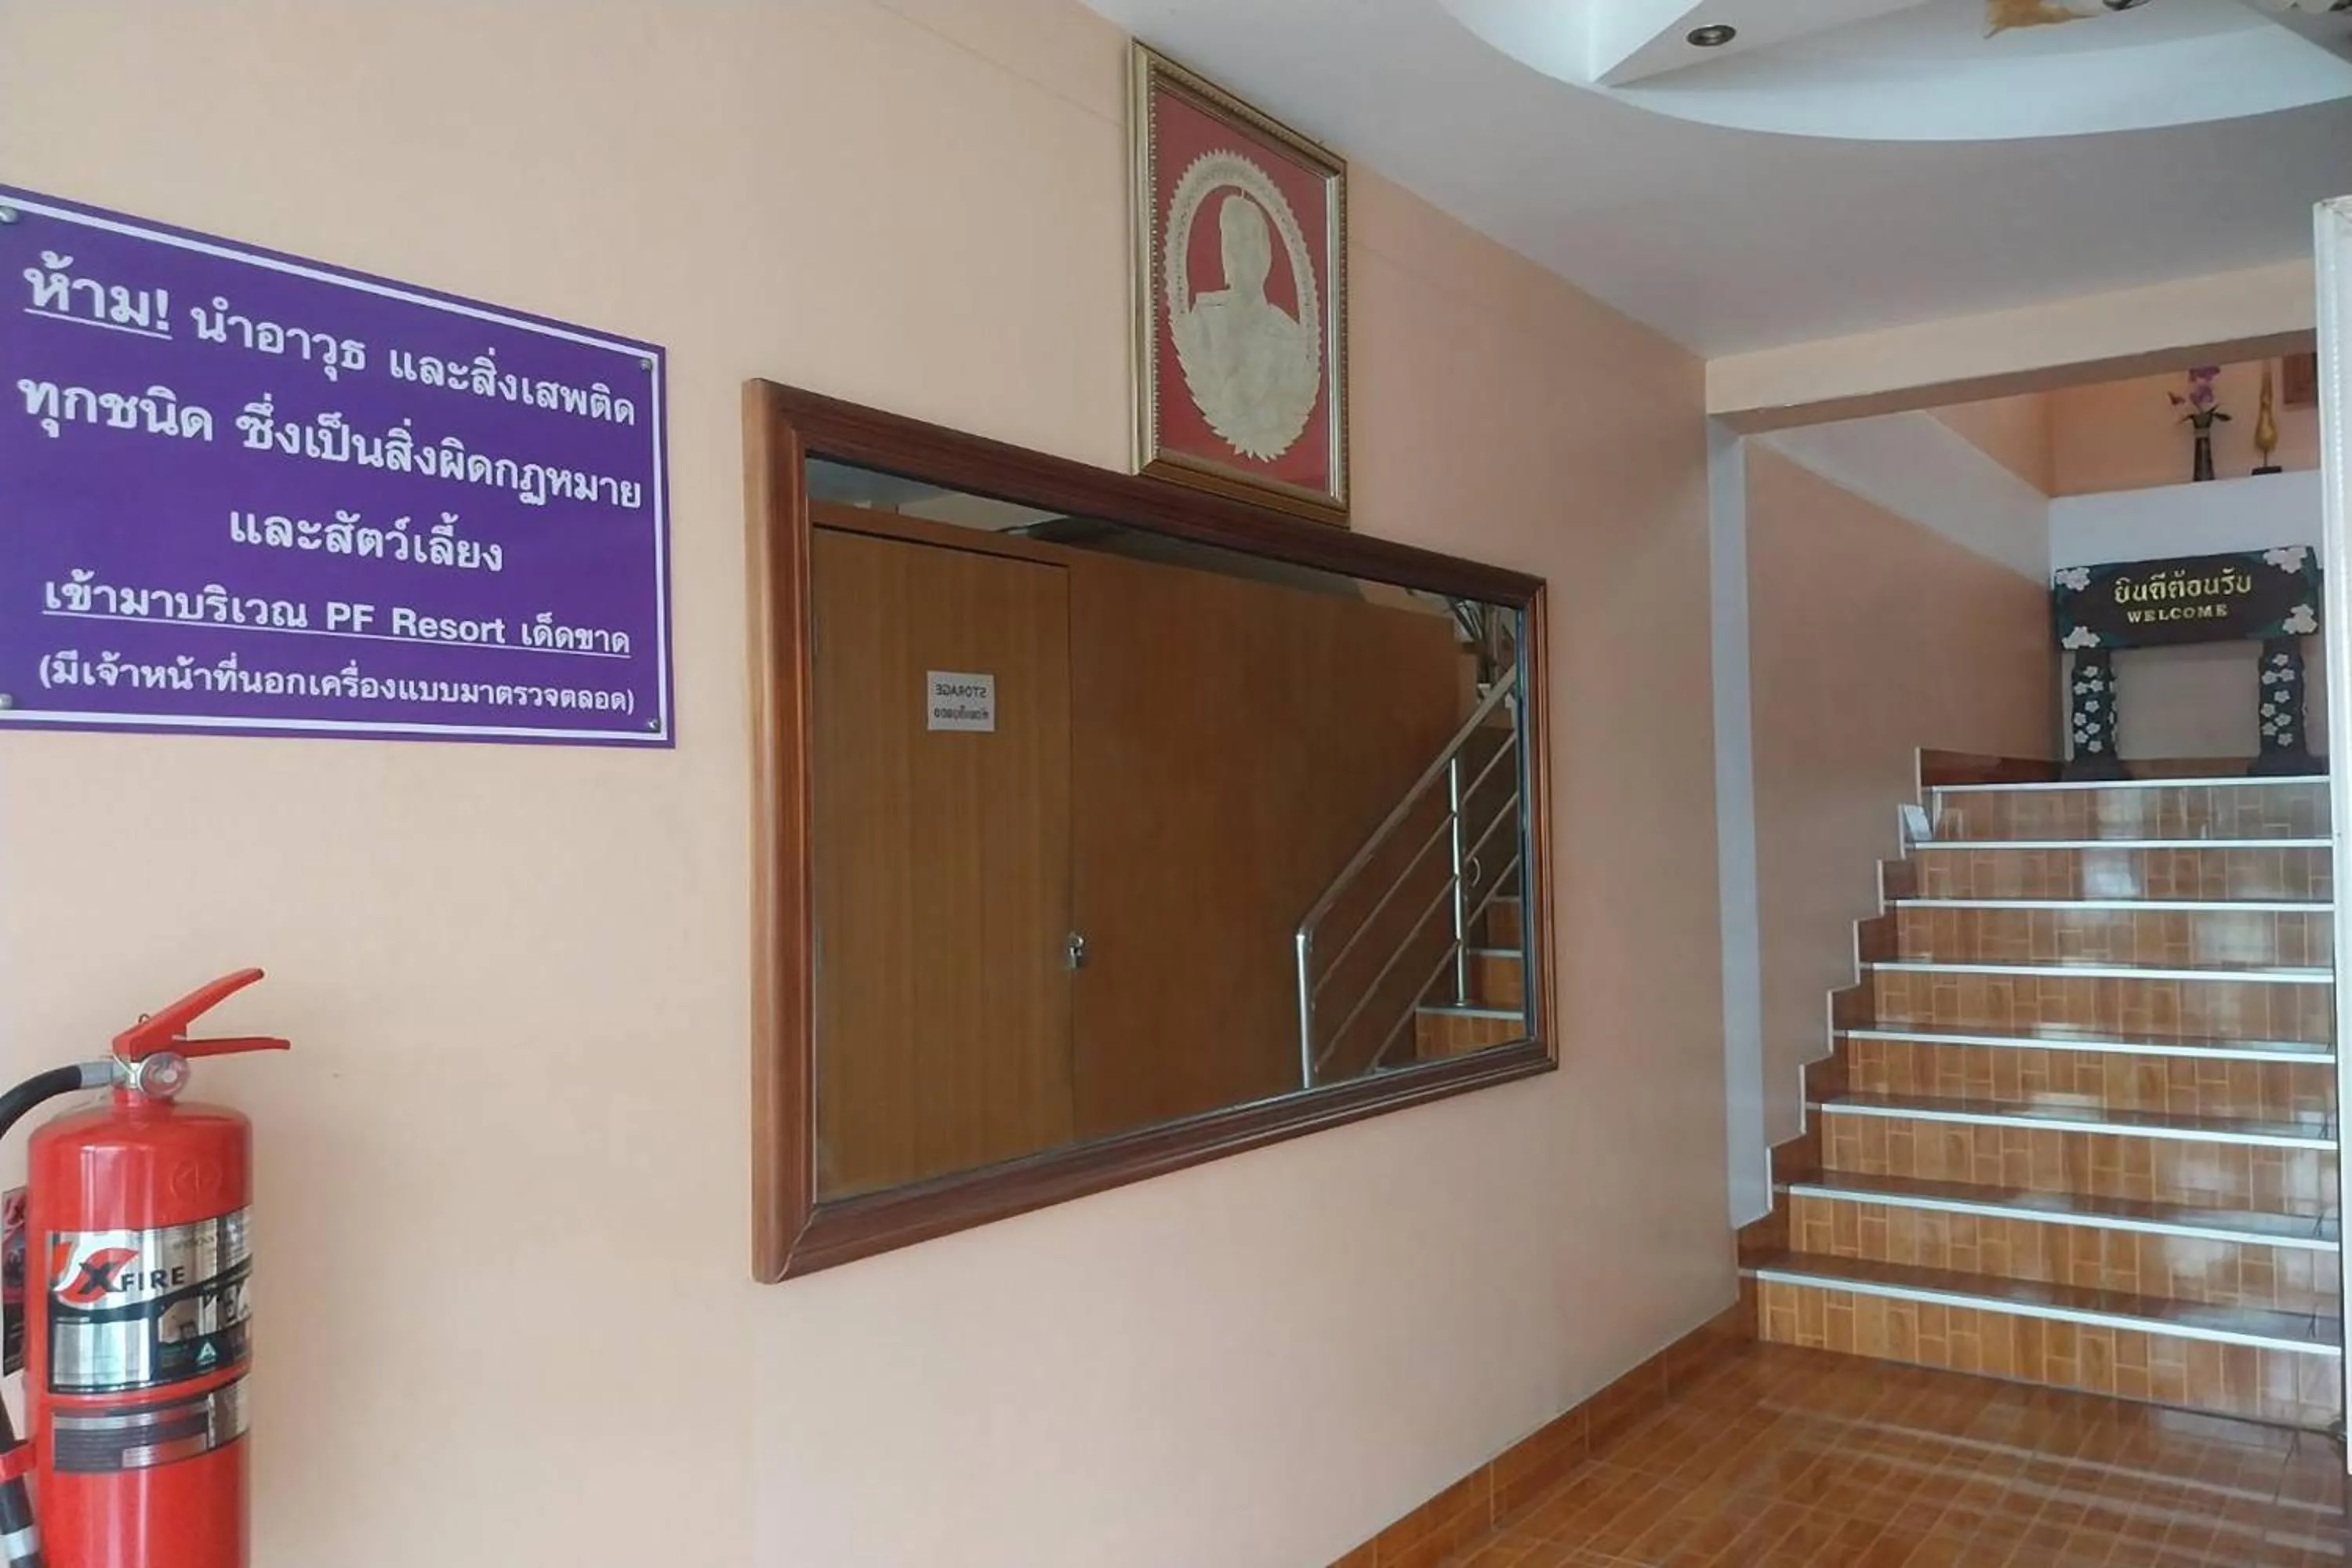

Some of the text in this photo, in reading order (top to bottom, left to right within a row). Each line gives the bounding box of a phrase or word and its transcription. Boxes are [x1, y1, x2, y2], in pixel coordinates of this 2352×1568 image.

[23, 250, 635, 426] ห้าม! นำอาวุธ และสิ่งเสพติด
[16, 378, 213, 441] ทุกชนิด
[230, 510, 503, 572] และสัตว์เลี้ยง
[45, 568, 630, 654] เข้ามาบริเวณ PF Resort เด็ดขาด
[2126, 603, 2228, 624] WELCOME
